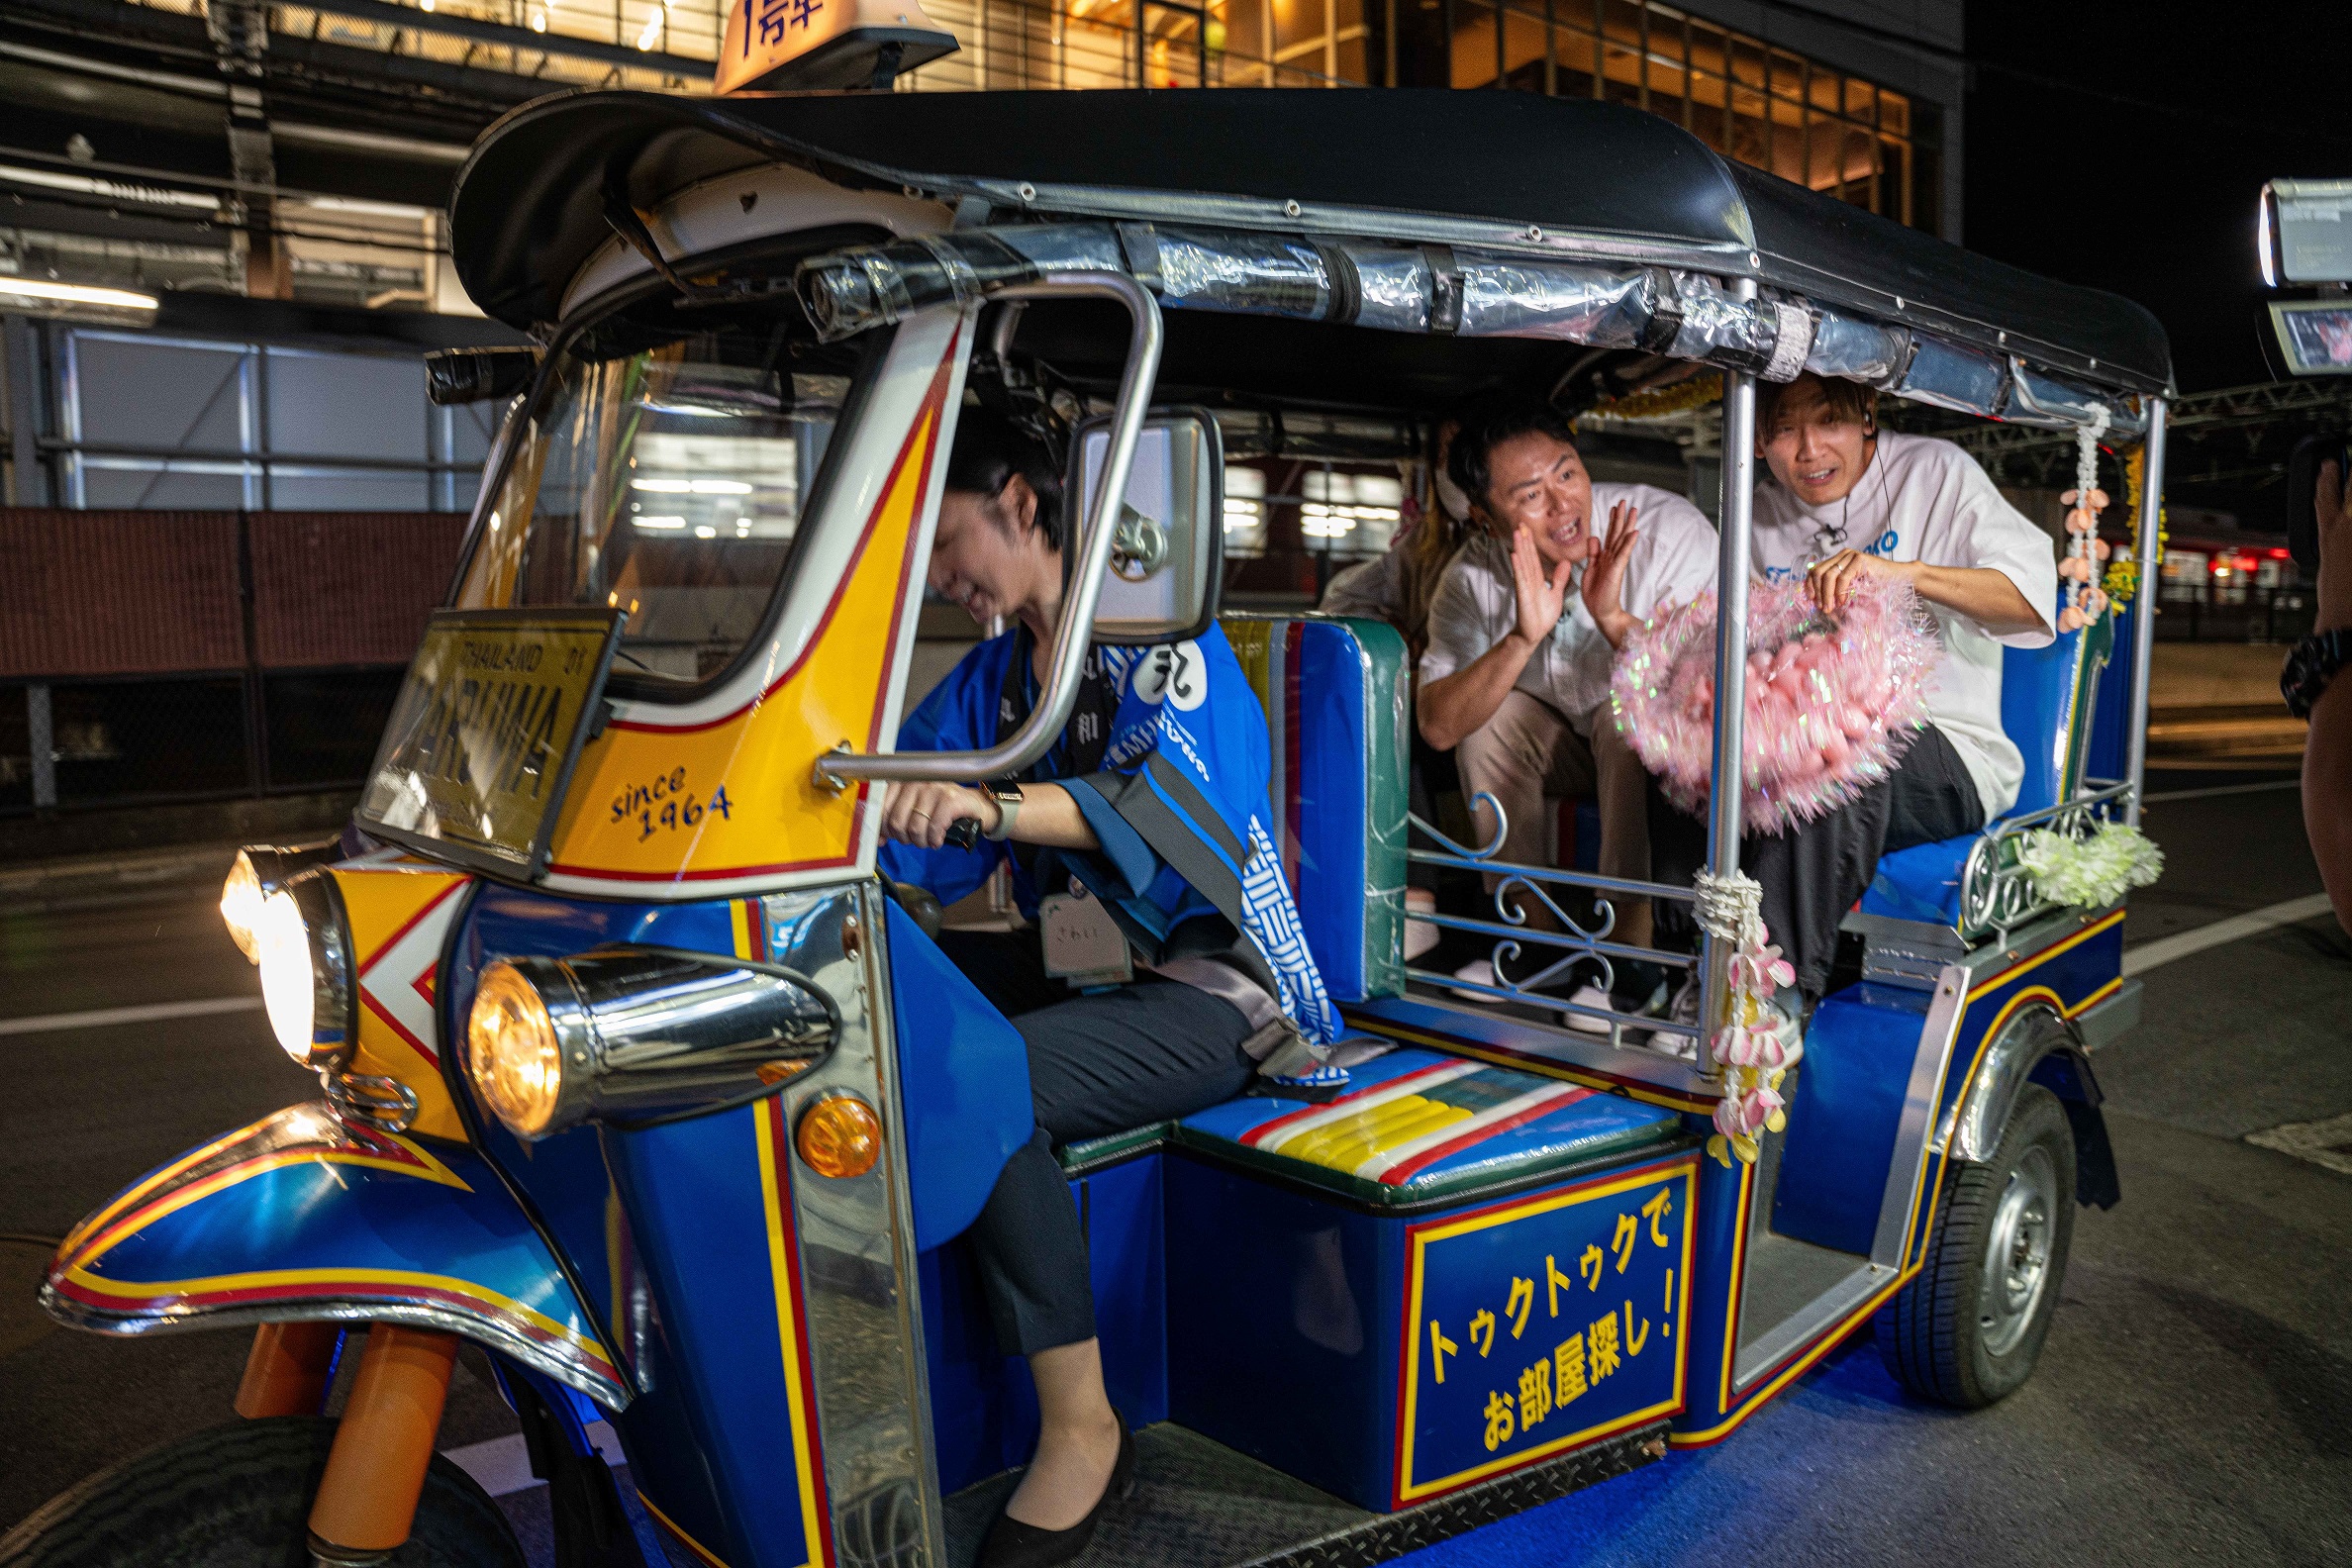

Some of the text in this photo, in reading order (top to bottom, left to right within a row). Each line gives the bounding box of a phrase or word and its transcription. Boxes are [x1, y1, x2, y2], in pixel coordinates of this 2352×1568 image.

[461, 640, 543, 673] THAILAND
[611, 765, 686, 824] since
[637, 783, 734, 844] 1964
[1429, 1185, 1673, 1385] トゥクトゥクで
[1483, 1267, 1675, 1452] お部屋探し!
